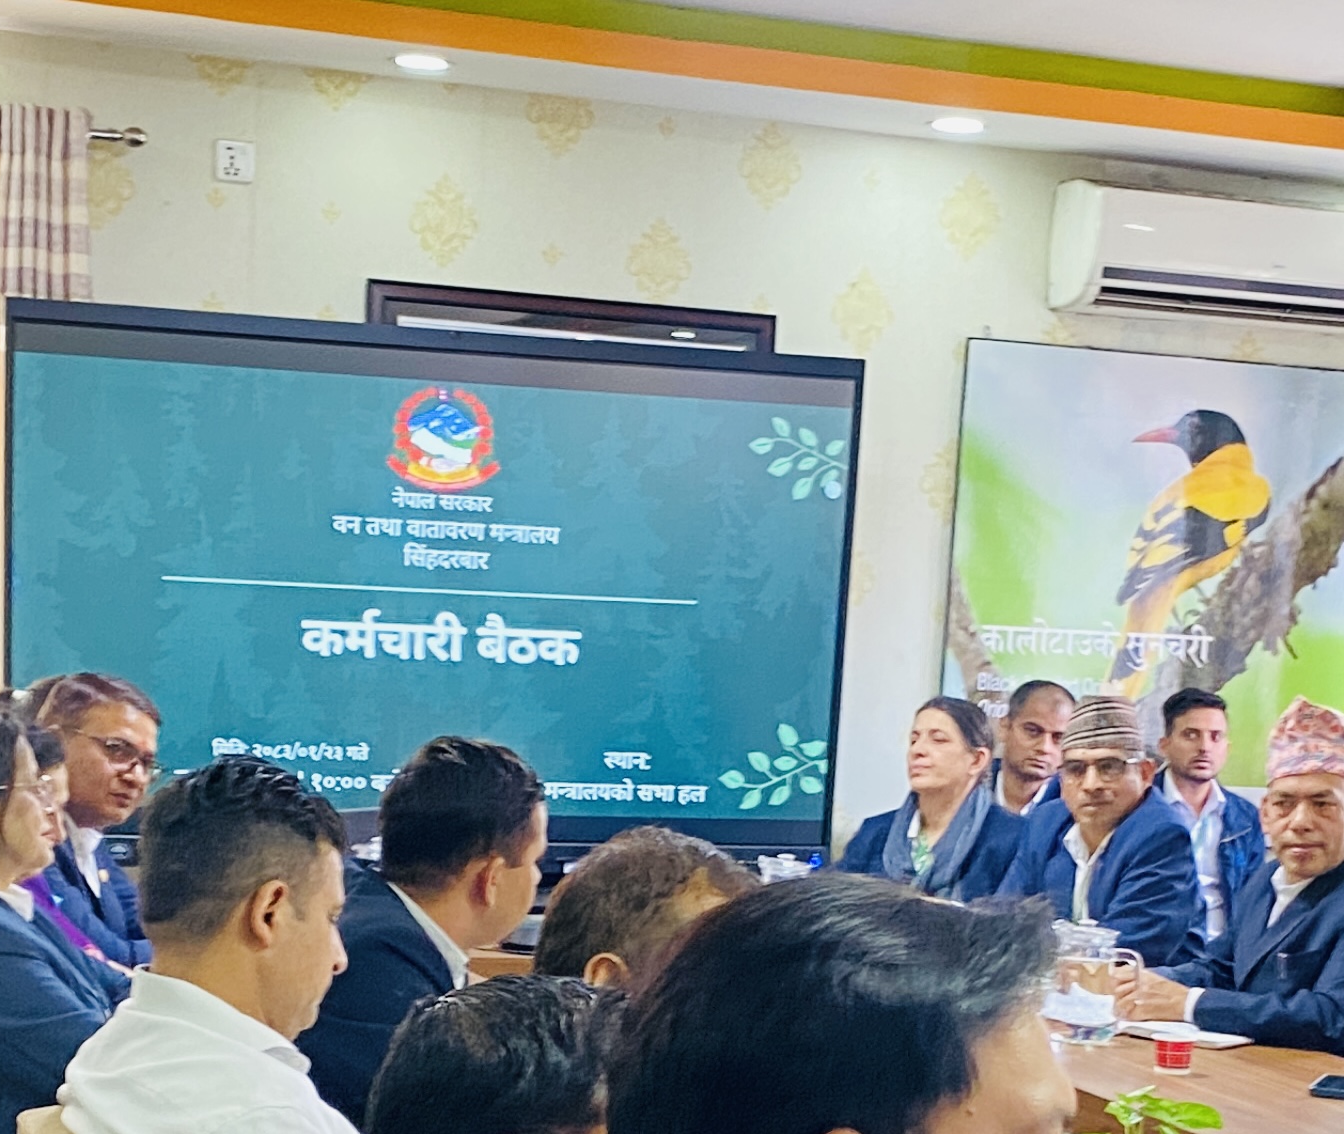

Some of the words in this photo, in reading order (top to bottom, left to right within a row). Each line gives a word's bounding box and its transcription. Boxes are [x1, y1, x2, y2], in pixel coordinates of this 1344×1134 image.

[391, 486, 437, 510] नेपाल
[438, 493, 494, 513] सरकार
[331, 514, 362, 535] वन
[364, 516, 404, 538] तथा
[405, 519, 486, 542] वातावरण
[488, 522, 561, 545] मन्त्रालय
[300, 607, 468, 663] कर्मचारी
[474, 612, 583, 667] बैठक
[311, 772, 368, 792] १०:००
[542, 778, 635, 802] मन्त्रालयको
[636, 784, 676, 803] सभा
[677, 785, 709, 805] हल
